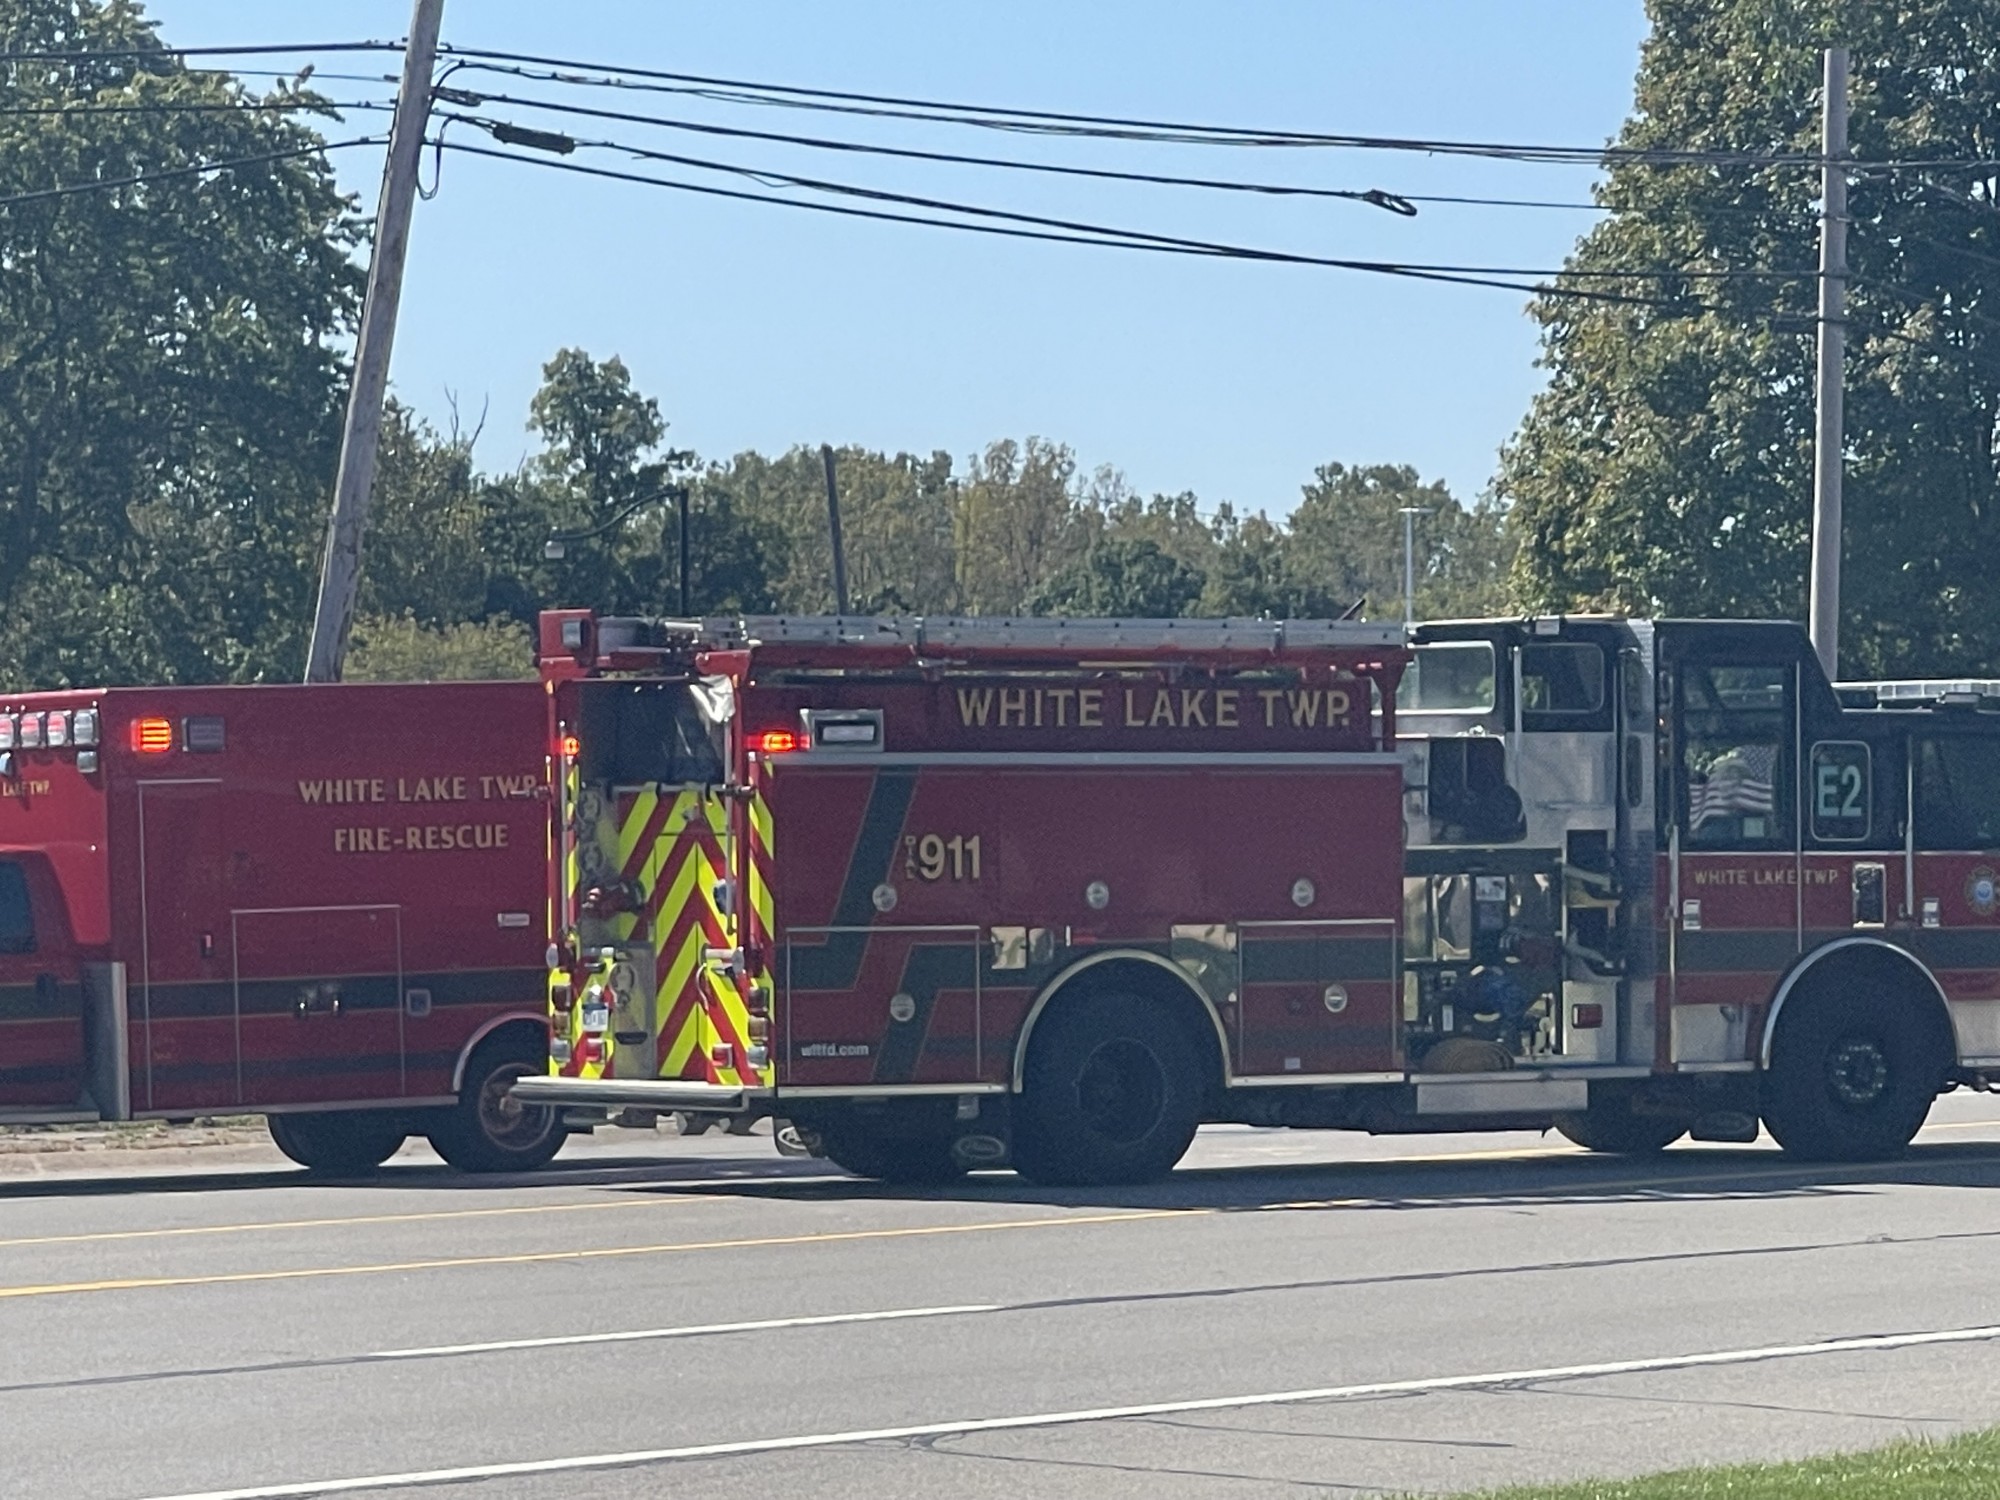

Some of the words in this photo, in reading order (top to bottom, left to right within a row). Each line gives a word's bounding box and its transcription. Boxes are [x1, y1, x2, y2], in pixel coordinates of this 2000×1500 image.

[956, 688, 1103, 727] WHITE
[1125, 689, 1240, 727] LAKE
[1258, 690, 1350, 727] TWP.
[299, 779, 385, 803] WHITE
[399, 777, 467, 802] LAKE
[1817, 765, 1862, 817] E2
[334, 824, 509, 852] FIRE-RESCUE
[919, 833, 980, 880] 911
[1694, 869, 1748, 885] WHITE
[1754, 869, 1797, 885] LAKE
[1803, 869, 1839, 884] TWP
